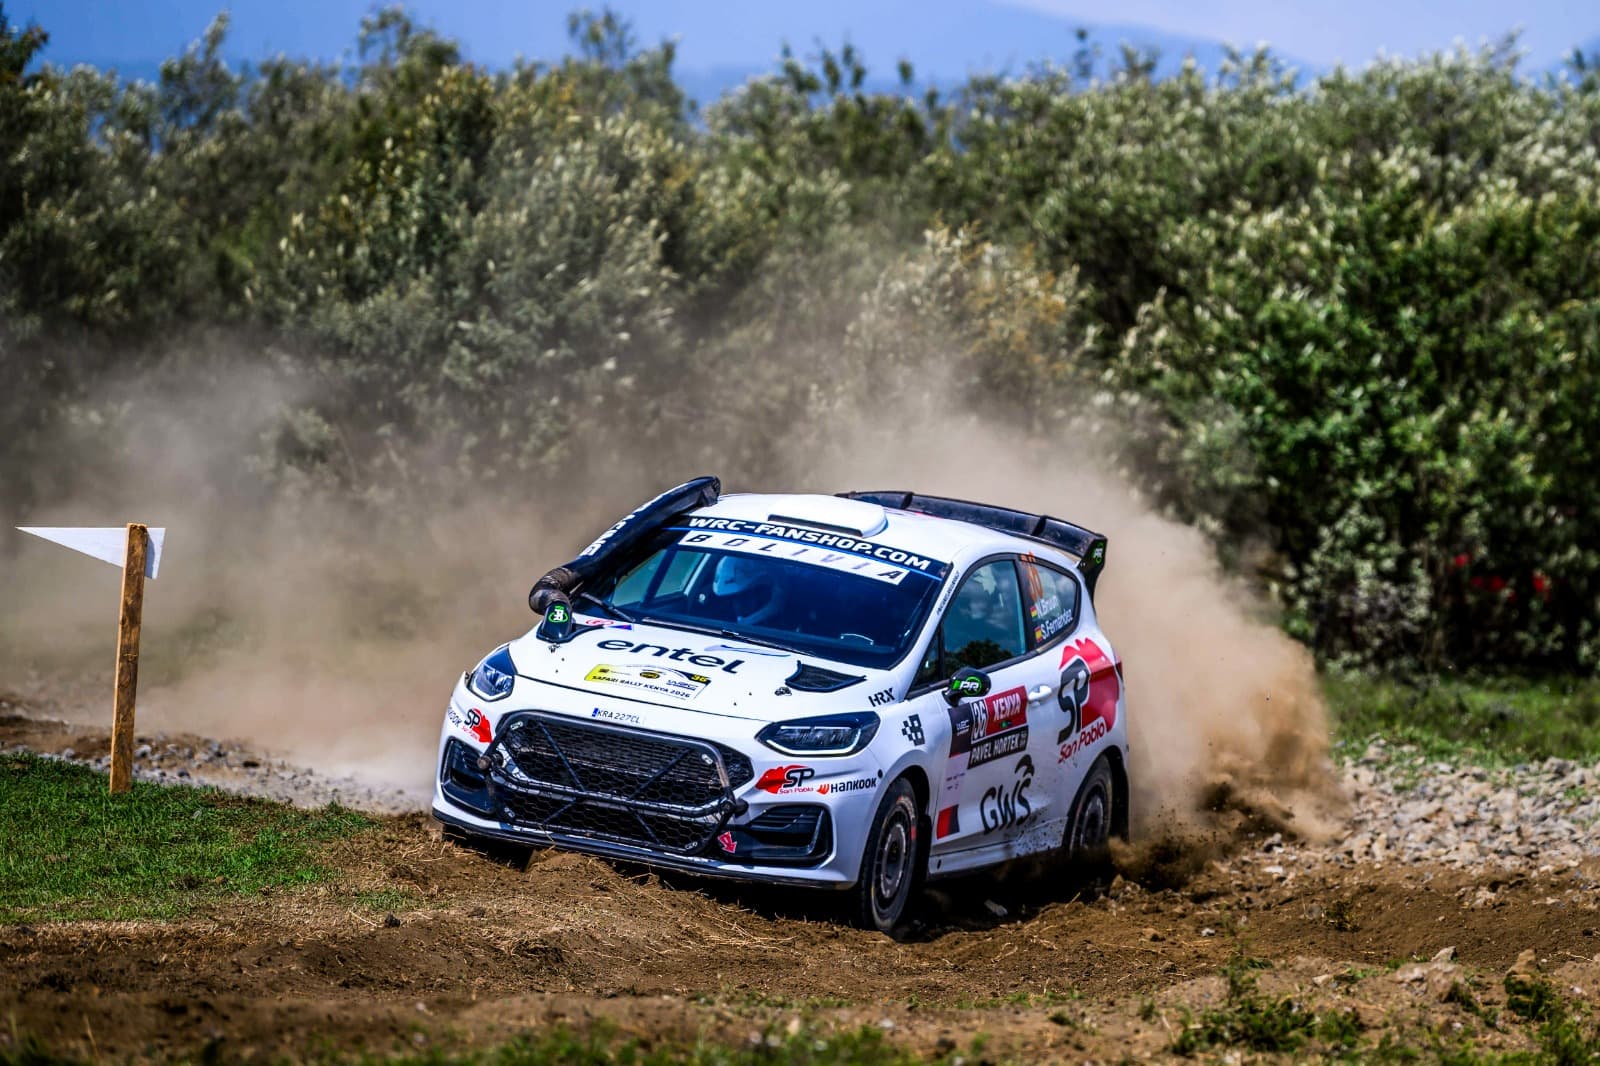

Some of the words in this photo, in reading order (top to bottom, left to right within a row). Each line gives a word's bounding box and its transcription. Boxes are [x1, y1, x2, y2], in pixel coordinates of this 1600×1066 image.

[686, 534, 903, 580] BOLIVIA
[688, 517, 931, 571] WRC-FANSHOP.COM
[597, 639, 745, 674] entel
[592, 675, 619, 683] SAFARI
[620, 679, 643, 688] RALLY
[643, 684, 669, 693] KENYA
[669, 689, 691, 698] 2026
[868, 687, 896, 707] HRX
[1057, 658, 1090, 745] SP
[464, 709, 481, 729] SP
[993, 693, 1021, 720] KENYA
[1058, 742, 1078, 764] San
[1078, 722, 1106, 752] Pablo
[782, 767, 815, 788] SP
[980, 778, 1032, 835] GWS
